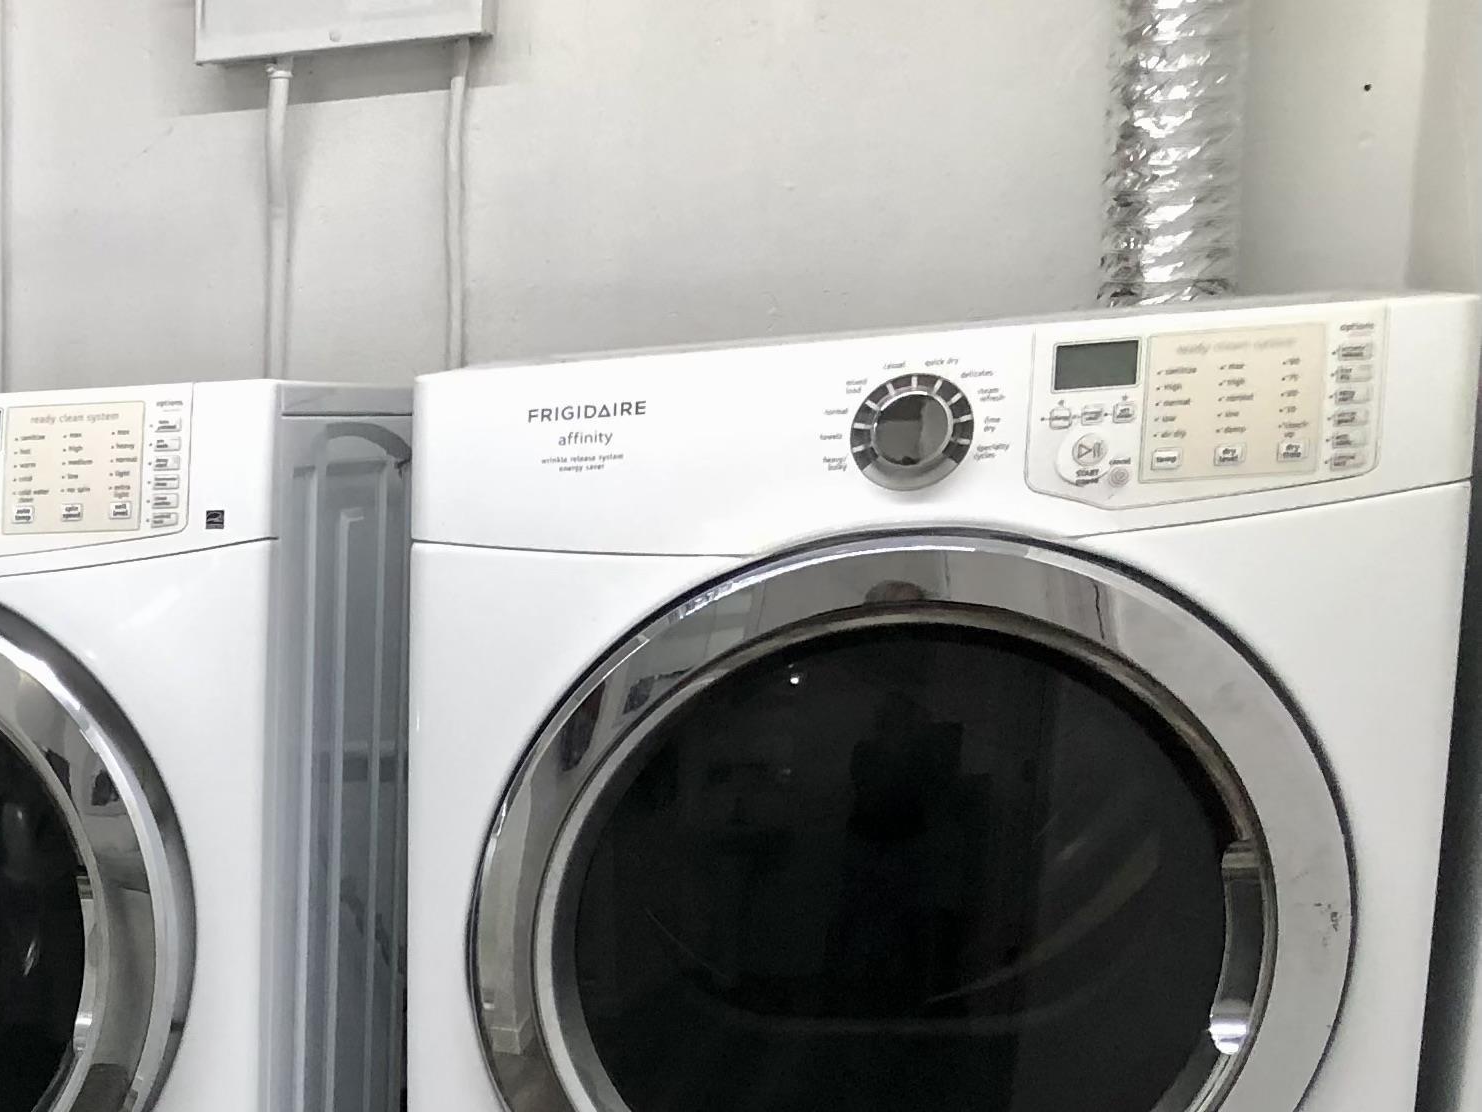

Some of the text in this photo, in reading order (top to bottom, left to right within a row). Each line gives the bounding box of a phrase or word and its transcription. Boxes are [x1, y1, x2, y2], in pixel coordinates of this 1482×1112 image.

[30, 413, 120, 425] ready clean system
[527, 400, 647, 424] FRIGIDAIRE
[558, 430, 614, 447] affinity
